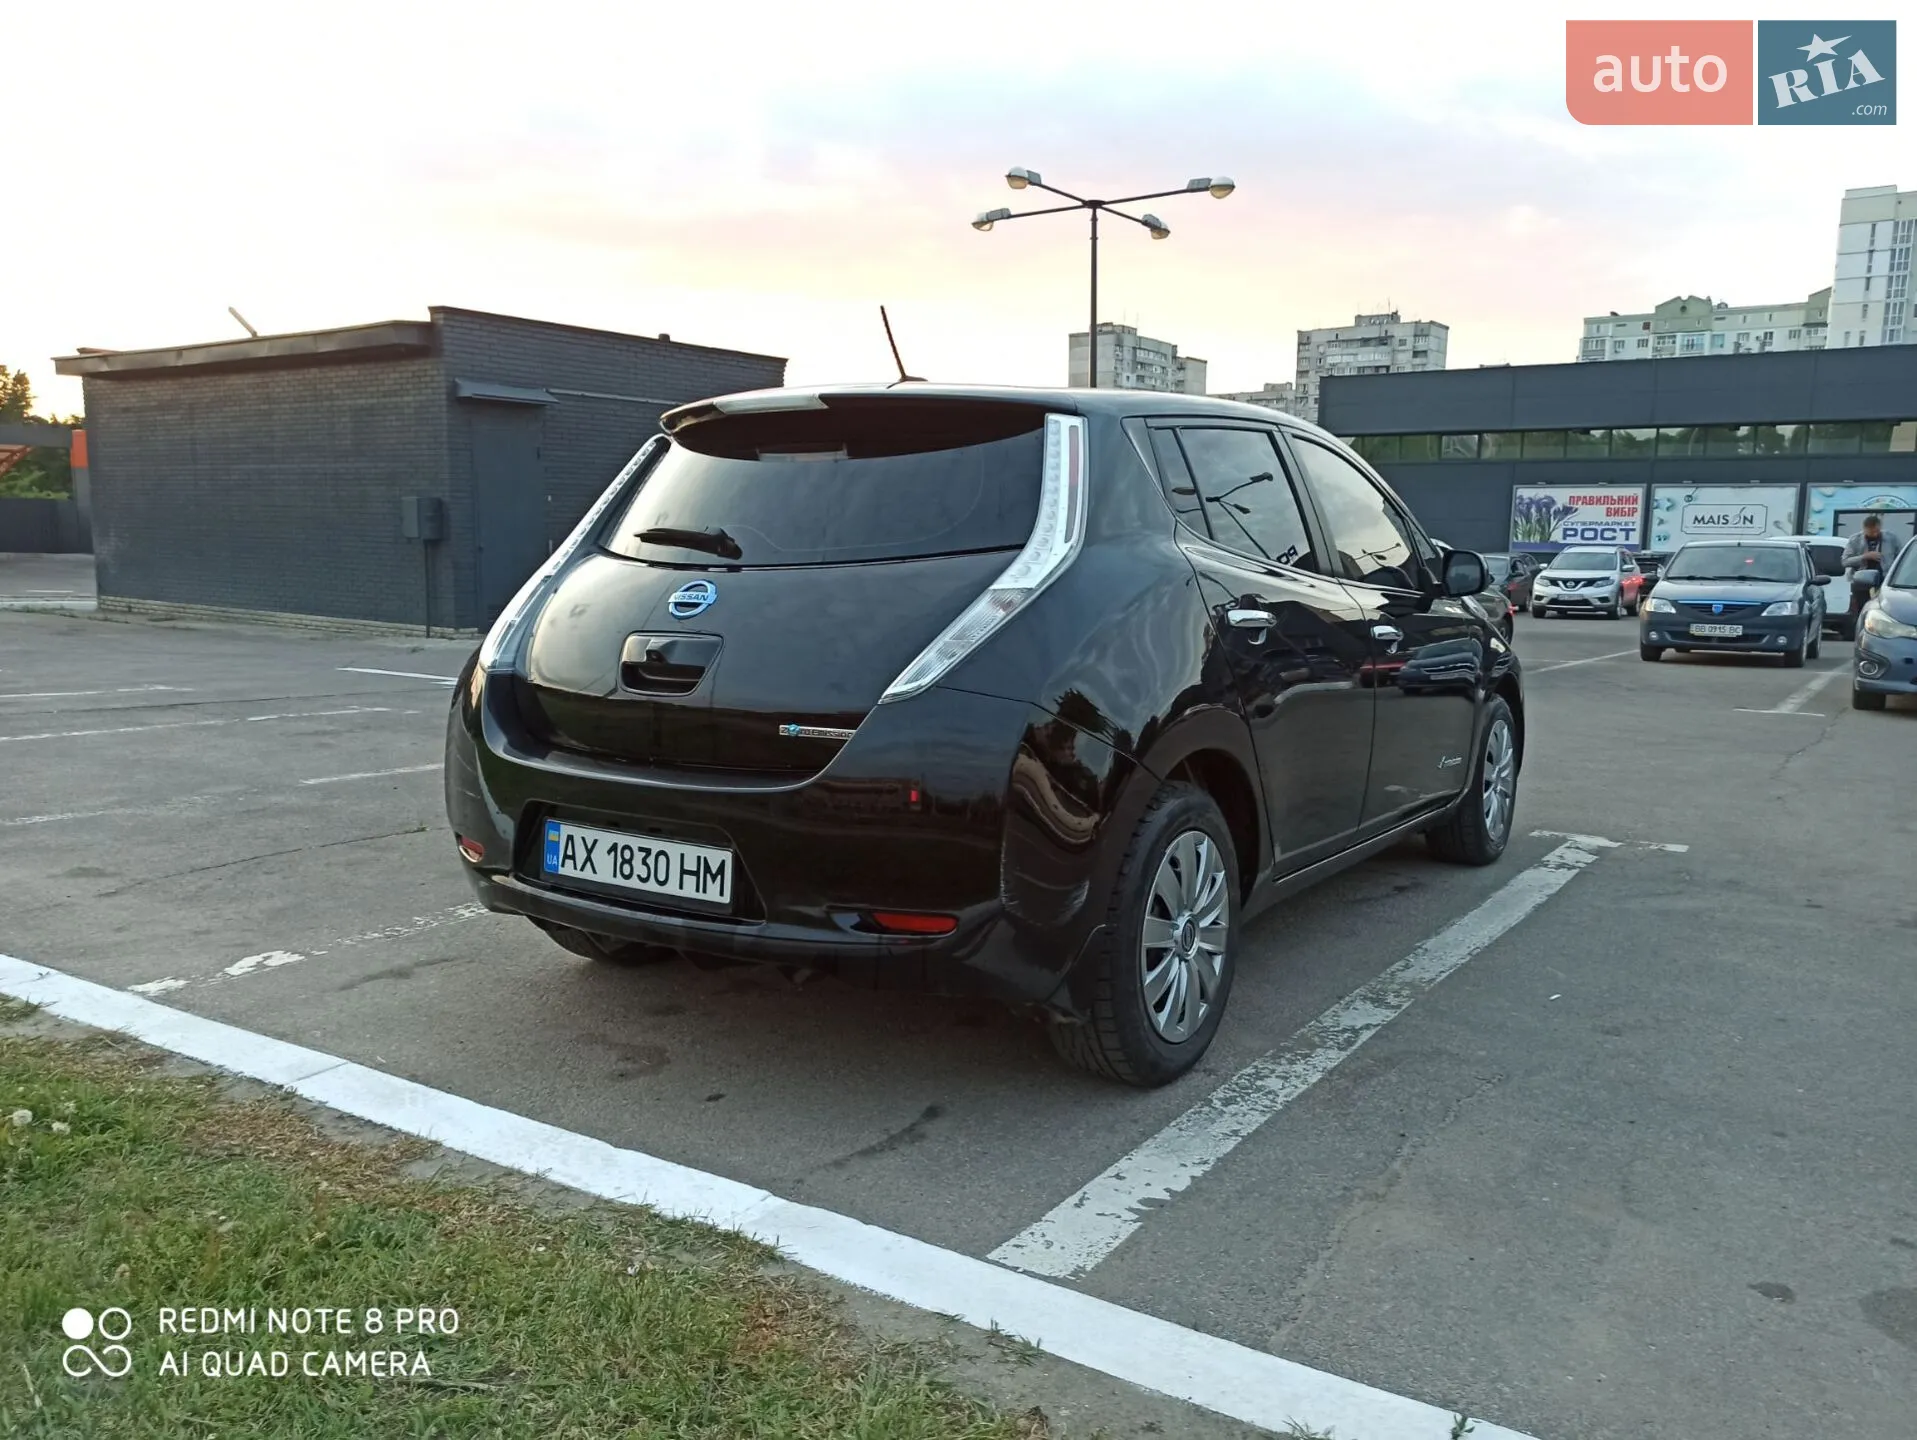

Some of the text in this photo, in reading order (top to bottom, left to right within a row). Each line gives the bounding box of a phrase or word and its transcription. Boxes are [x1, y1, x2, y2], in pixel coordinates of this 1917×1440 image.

[1568, 494, 1639, 506] ПРАВИЛЬНИЙ
[1605, 507, 1638, 517] ВИБІР
[1691, 510, 1754, 525] MAISON
[1562, 527, 1637, 541] РОСТ
[674, 592, 709, 602] NISSAN
[546, 854, 558, 866] UA
[560, 834, 726, 897] AX 1830 HM
